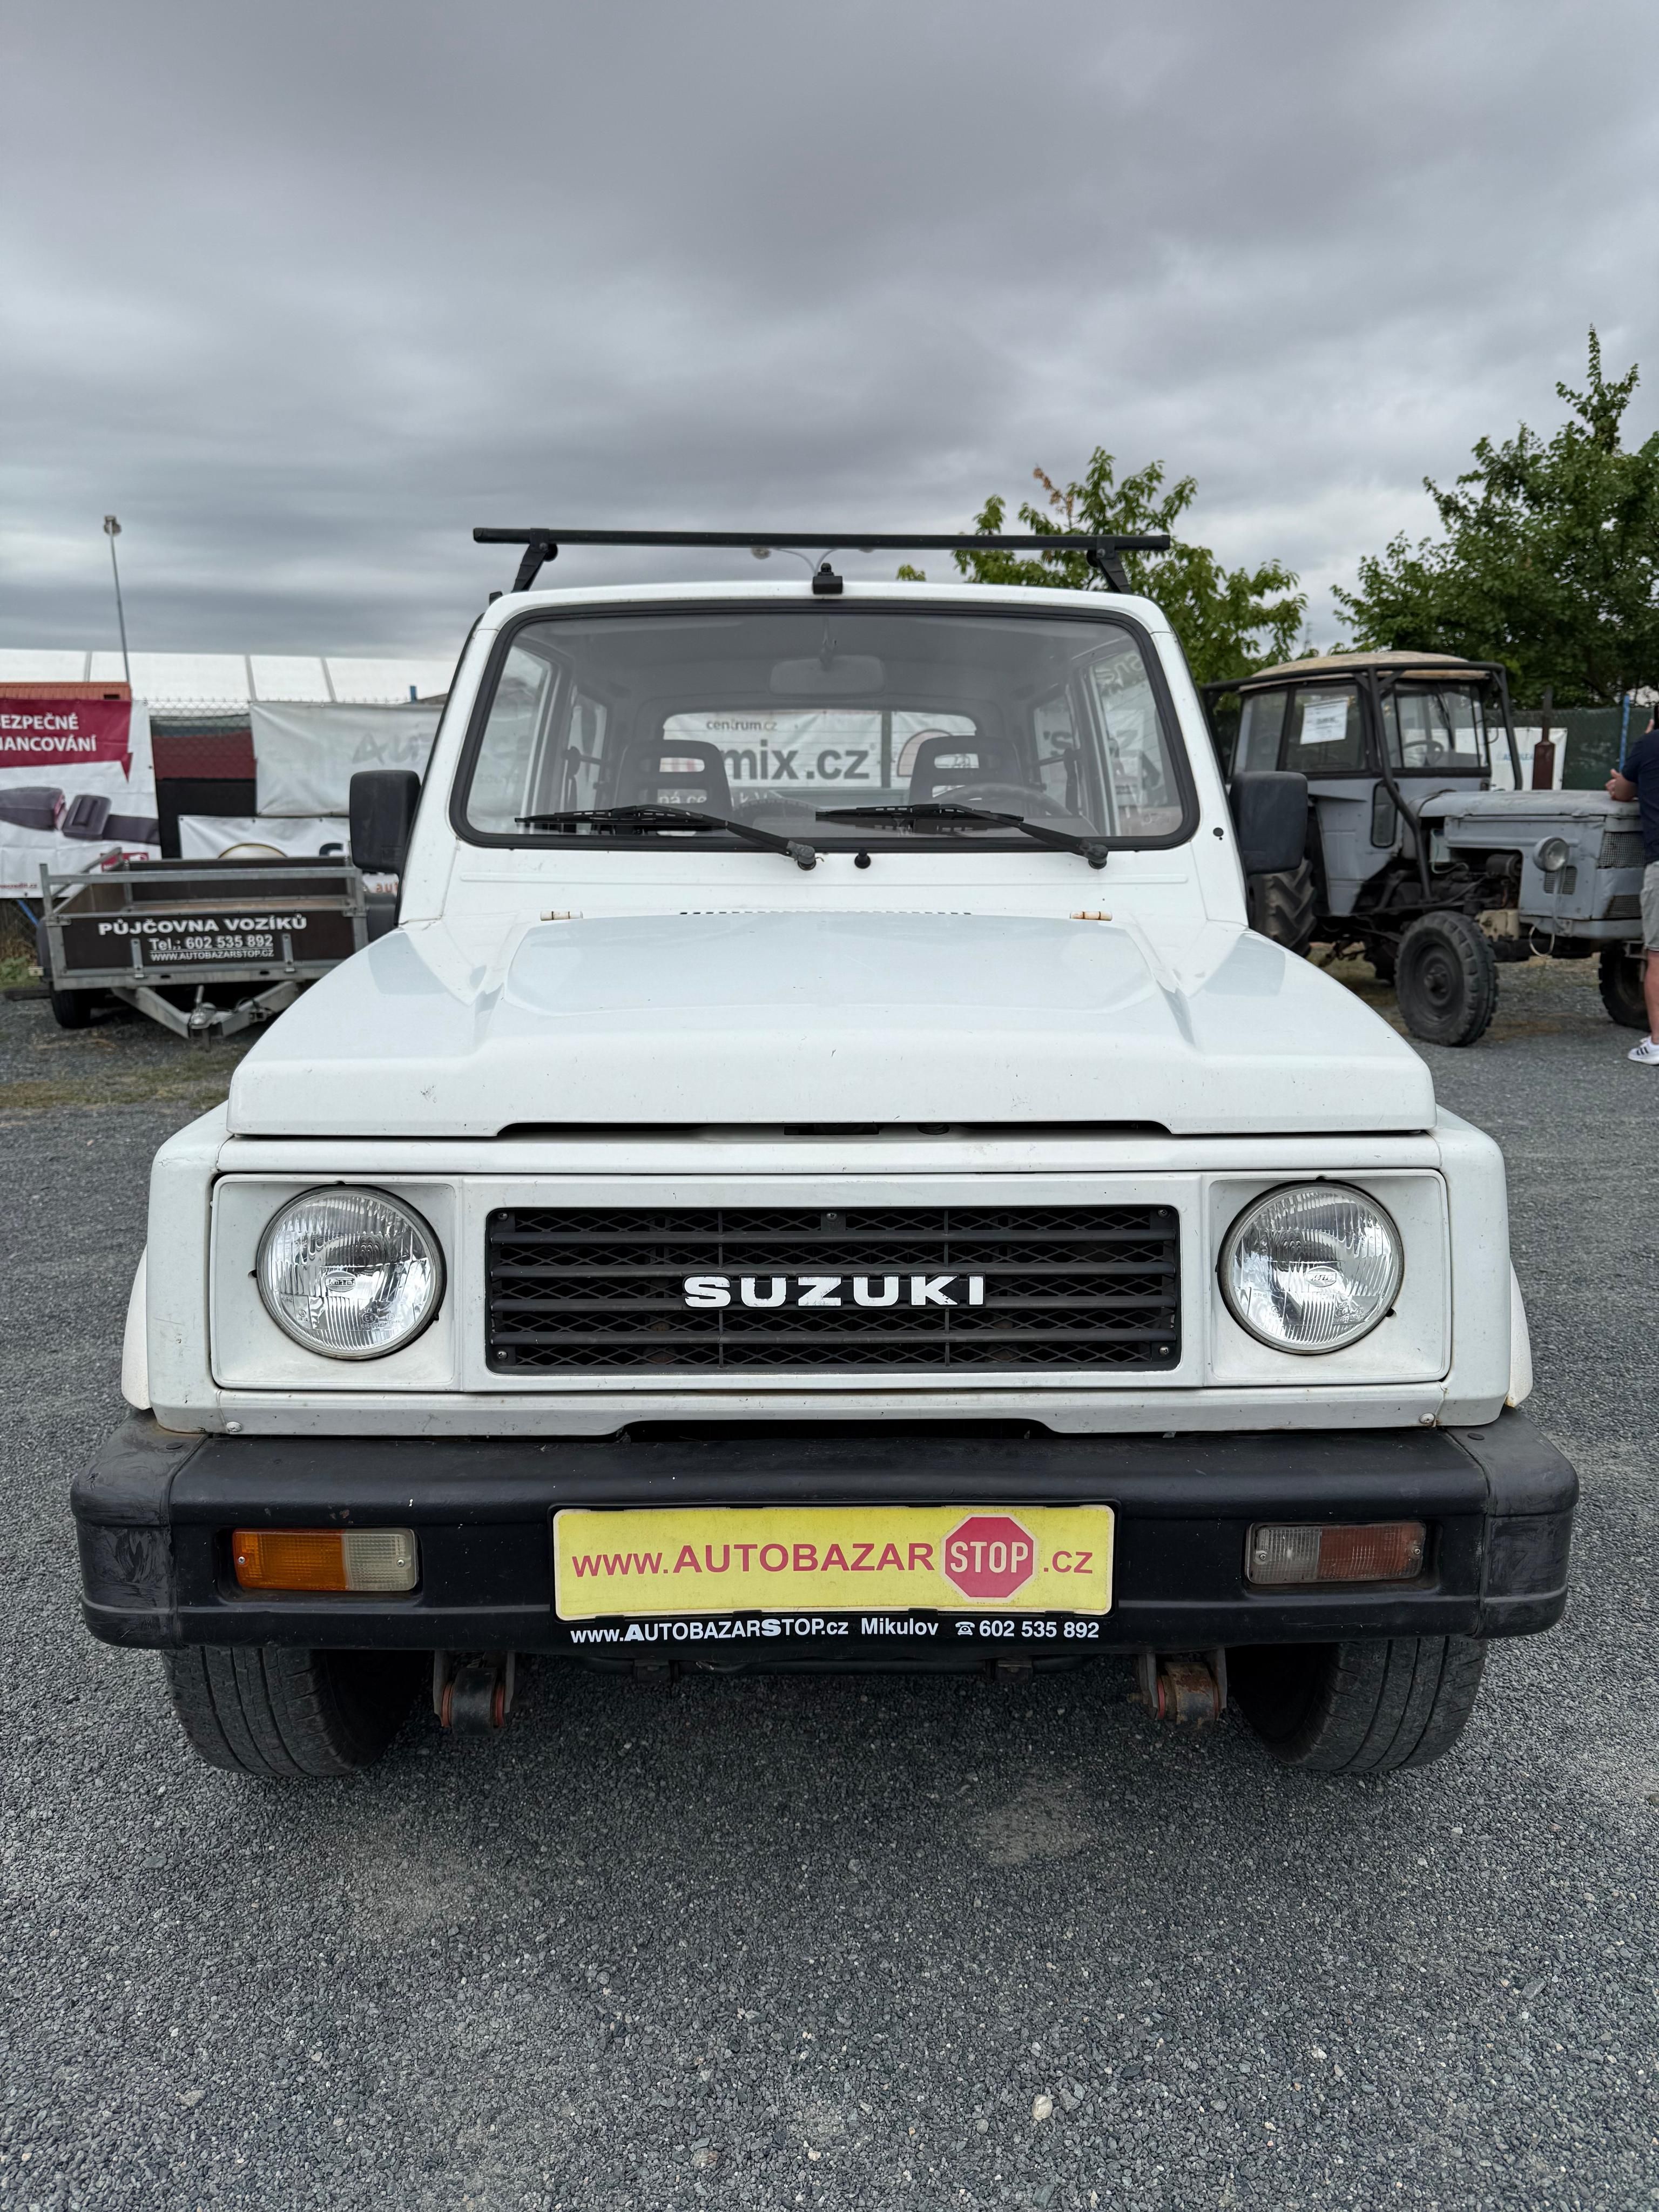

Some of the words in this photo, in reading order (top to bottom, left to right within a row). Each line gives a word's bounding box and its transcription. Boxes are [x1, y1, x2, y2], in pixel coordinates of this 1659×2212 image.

[0, 712, 79, 730] EZPEČNÉ
[98, 918, 220, 935] PŮJČOVNA
[224, 913, 307, 931] VOZÍKŮ
[148, 937, 181, 950] Tel.:
[185, 936, 213, 949] 602
[217, 935, 243, 948] 535
[247, 934, 274, 947] 892
[684, 1276, 983, 1307] SUZUKI
[950, 1541, 1029, 1573] STOP
[570, 1618, 849, 1643] www.AUTOBAZARSTOP.cz
[861, 1617, 939, 1635] Mikulov
[979, 1620, 1015, 1637] 602
[1021, 1621, 1057, 1637] 535
[1063, 1621, 1100, 1638] 892
